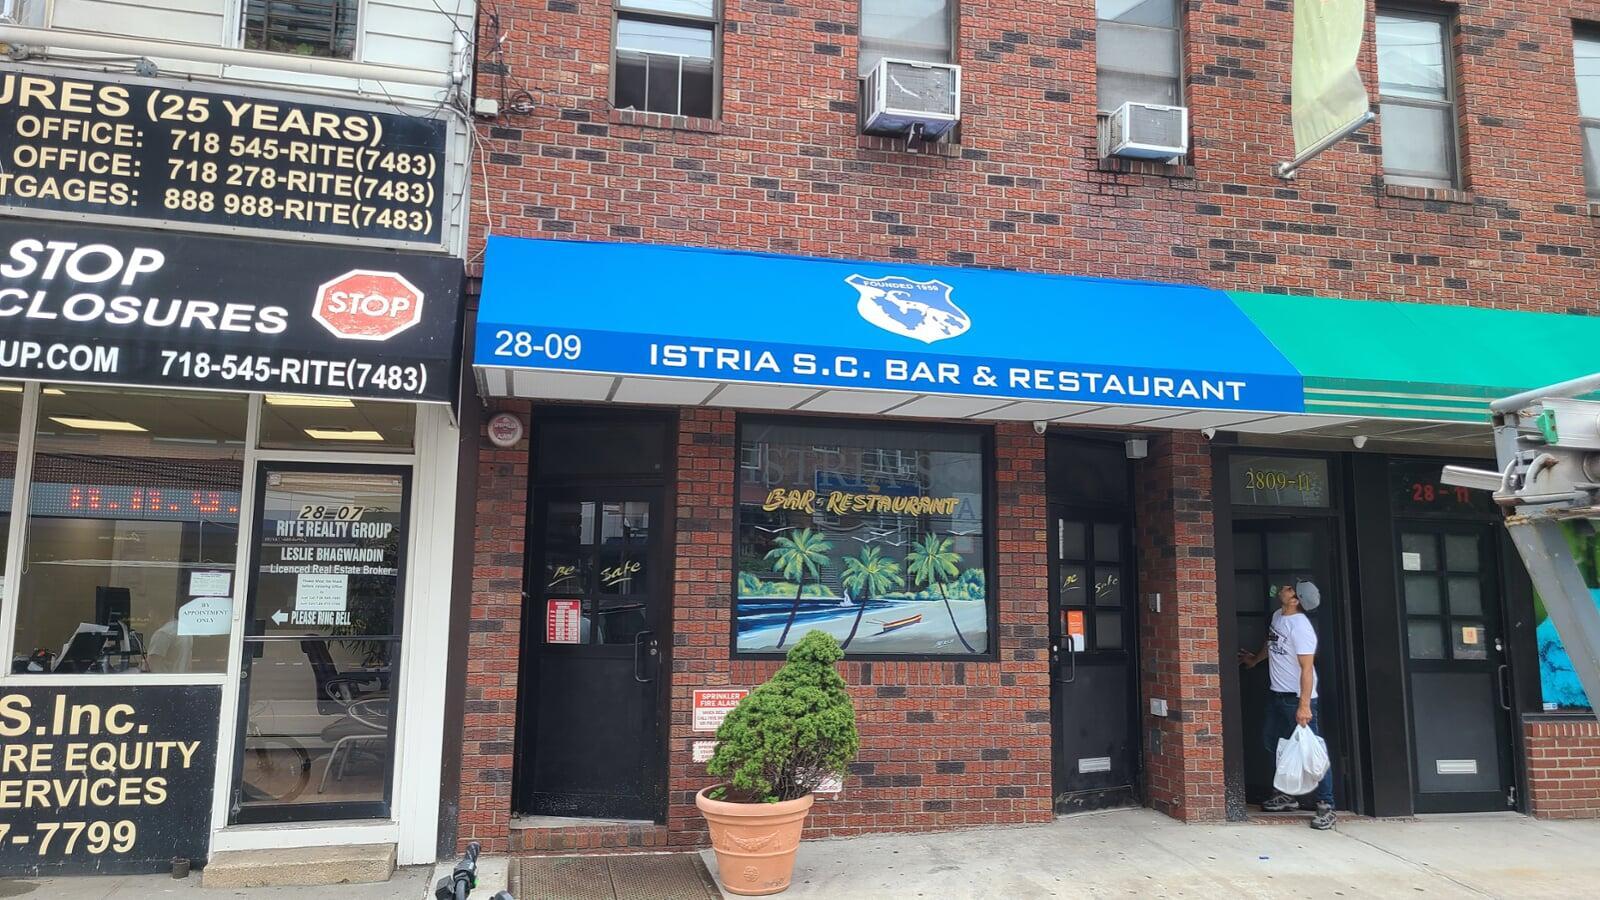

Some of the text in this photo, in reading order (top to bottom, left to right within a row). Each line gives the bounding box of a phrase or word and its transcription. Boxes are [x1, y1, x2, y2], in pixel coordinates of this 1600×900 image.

[147, 90, 210, 123] (25
[221, 100, 383, 145] YEARS)
[16, 115, 437, 180] OFFICE: 718 545-RITE(7483)
[13, 145, 435, 207] OFFICE: 718 278-RITE(7483)
[164, 188, 215, 213] 888
[224, 191, 433, 236] 988-RITE(7483)
[0, 238, 165, 286] STOP
[0, 288, 289, 334] CLOSURES
[327, 289, 411, 319] STOP
[493, 330, 582, 360] 28-09
[0, 339, 427, 394] UP.COM 718-545-RITE(7483)
[650, 343, 1247, 402] ISTRIA S.C. BAR & RESTAURANT
[762, 487, 817, 514] BAR
[826, 490, 960, 516] RESTAURANT
[276, 520, 393, 539] RITE REALTY GROUP
[270, 563, 391, 576] Licenced Real Estate Broker
[281, 547, 384, 562] LESLIE BHAGWANDIN
[290, 610, 352, 625] PLEASE RING BELL
[699, 699, 716, 708] FIRE
[702, 692, 740, 700] SPRINKLER
[0, 693, 148, 736] S.Inc.
[64, 740, 201, 772] EQUITY
[0, 776, 168, 809] ERVICES
